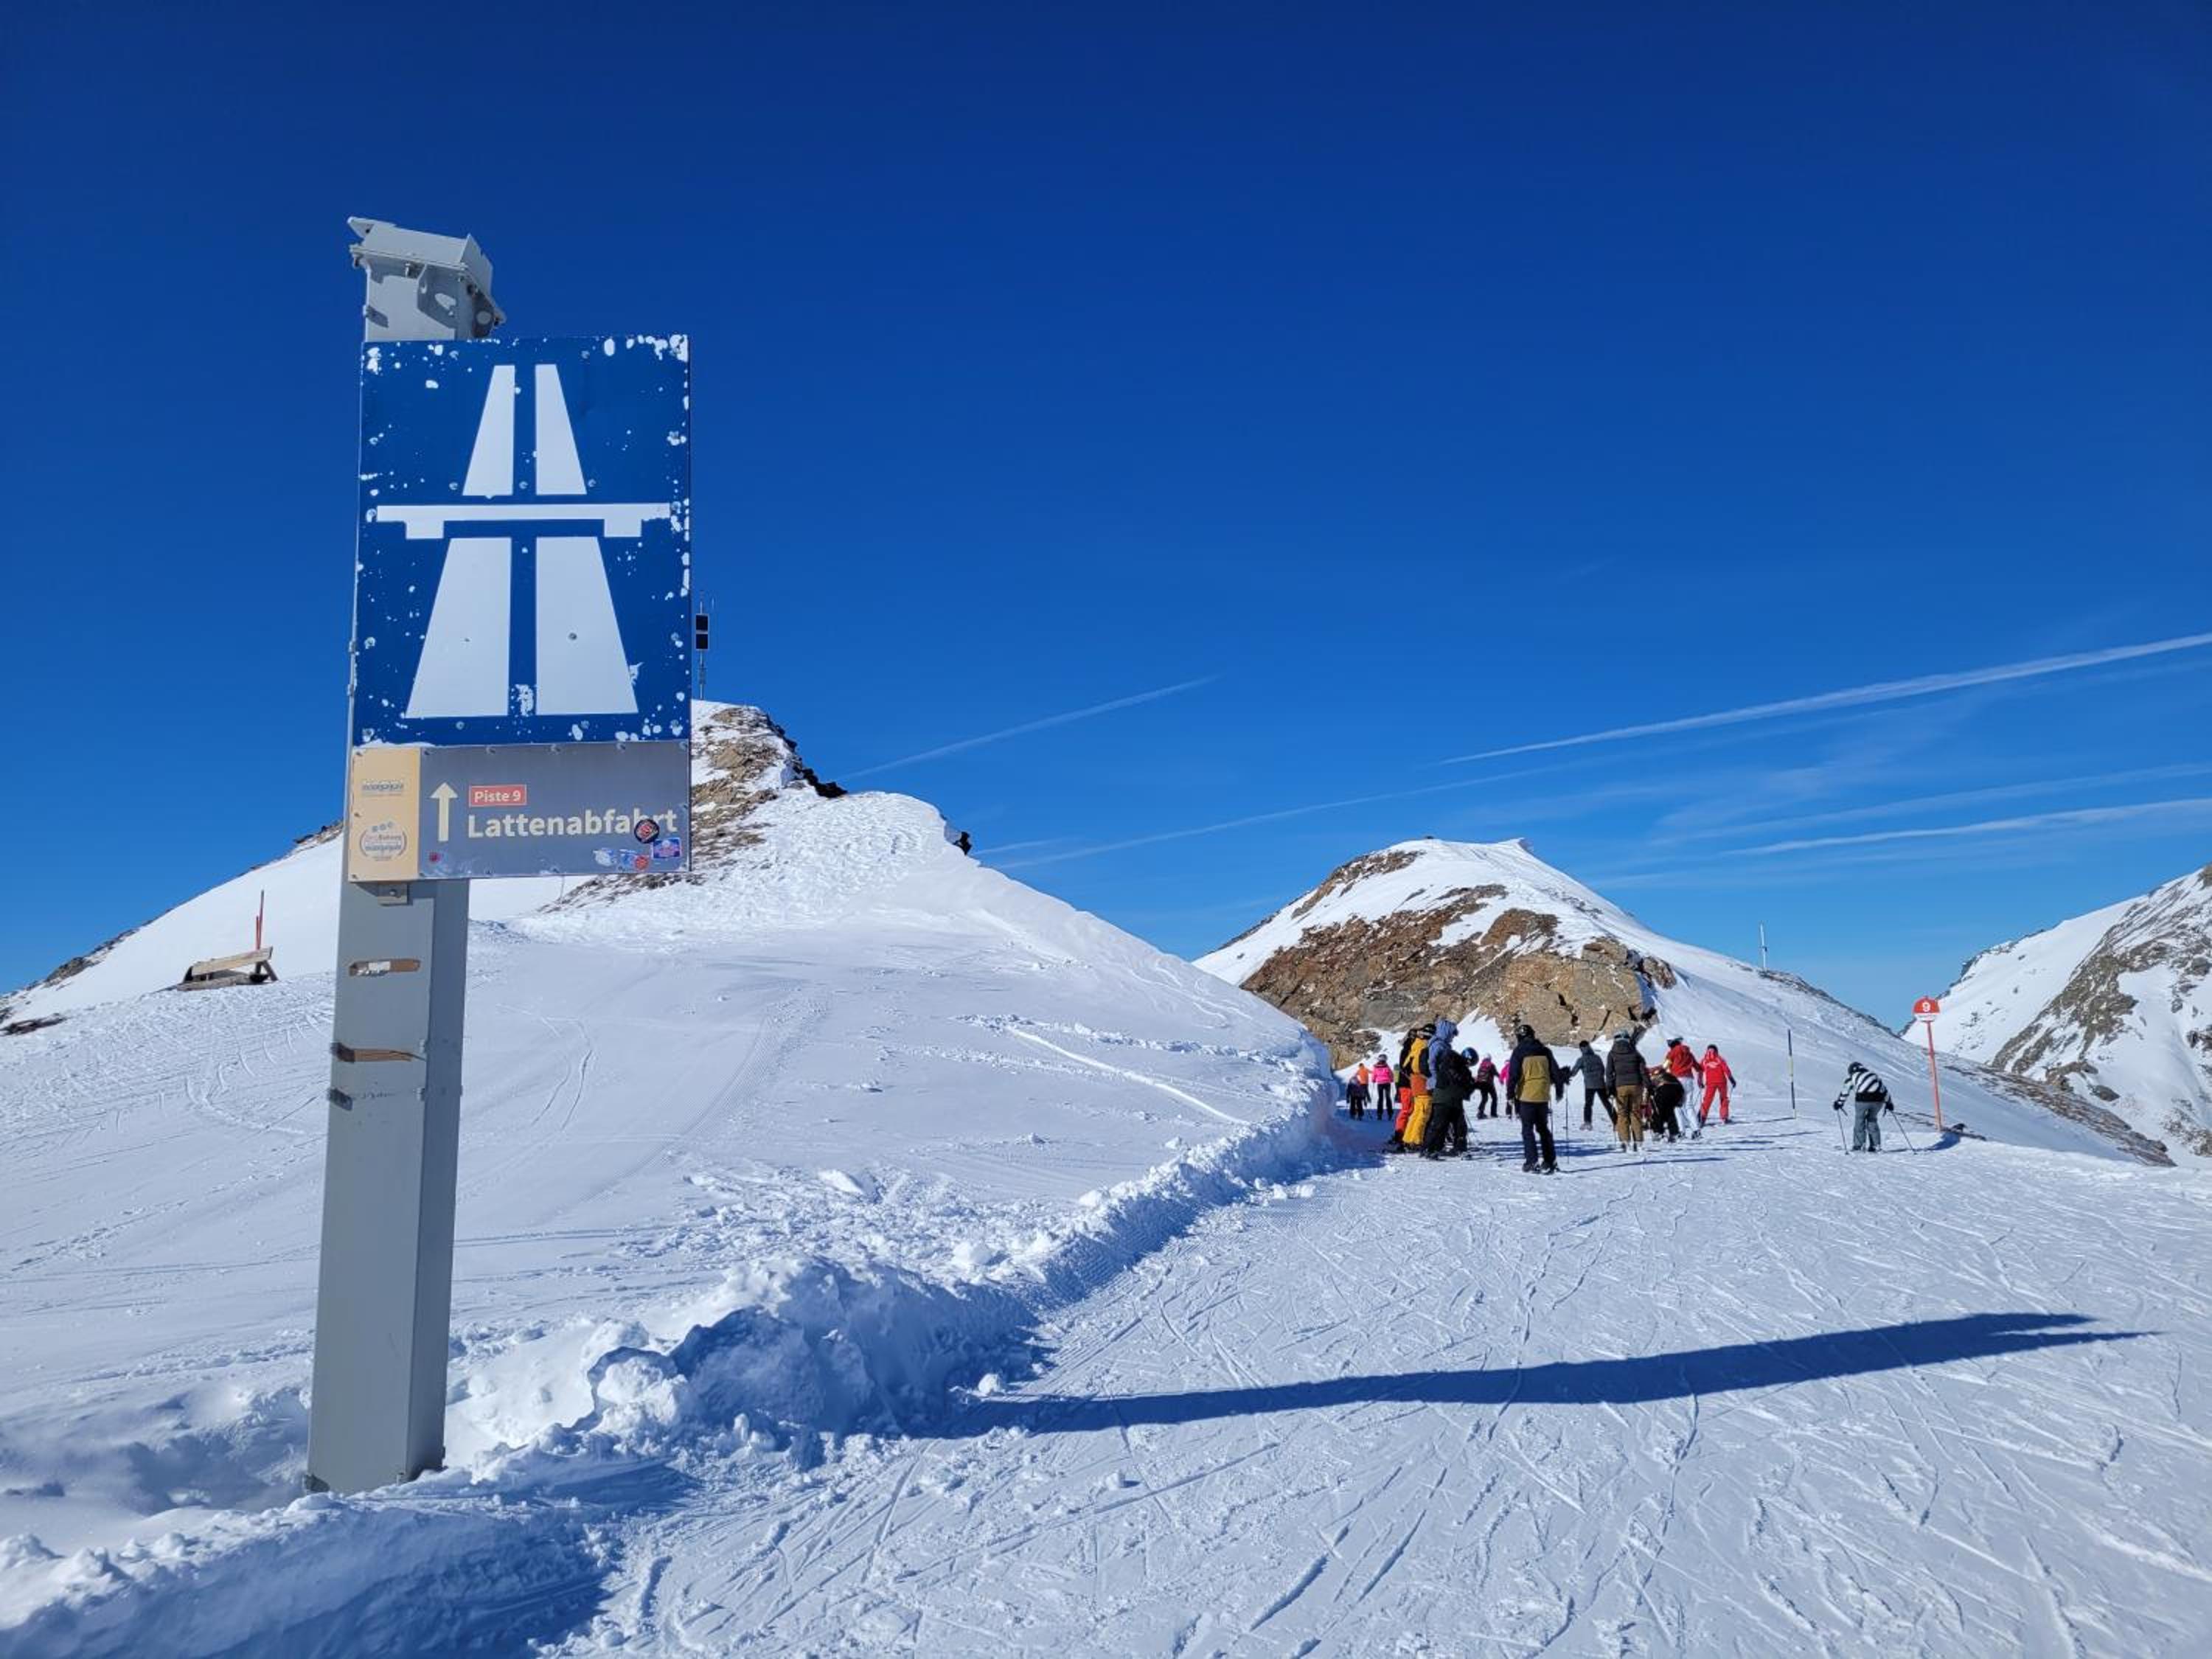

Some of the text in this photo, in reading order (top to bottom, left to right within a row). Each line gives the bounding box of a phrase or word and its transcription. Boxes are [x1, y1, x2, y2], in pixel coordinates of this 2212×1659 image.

[475, 790, 521, 803] Piste 9
[1922, 1001, 1930, 1012] 9
